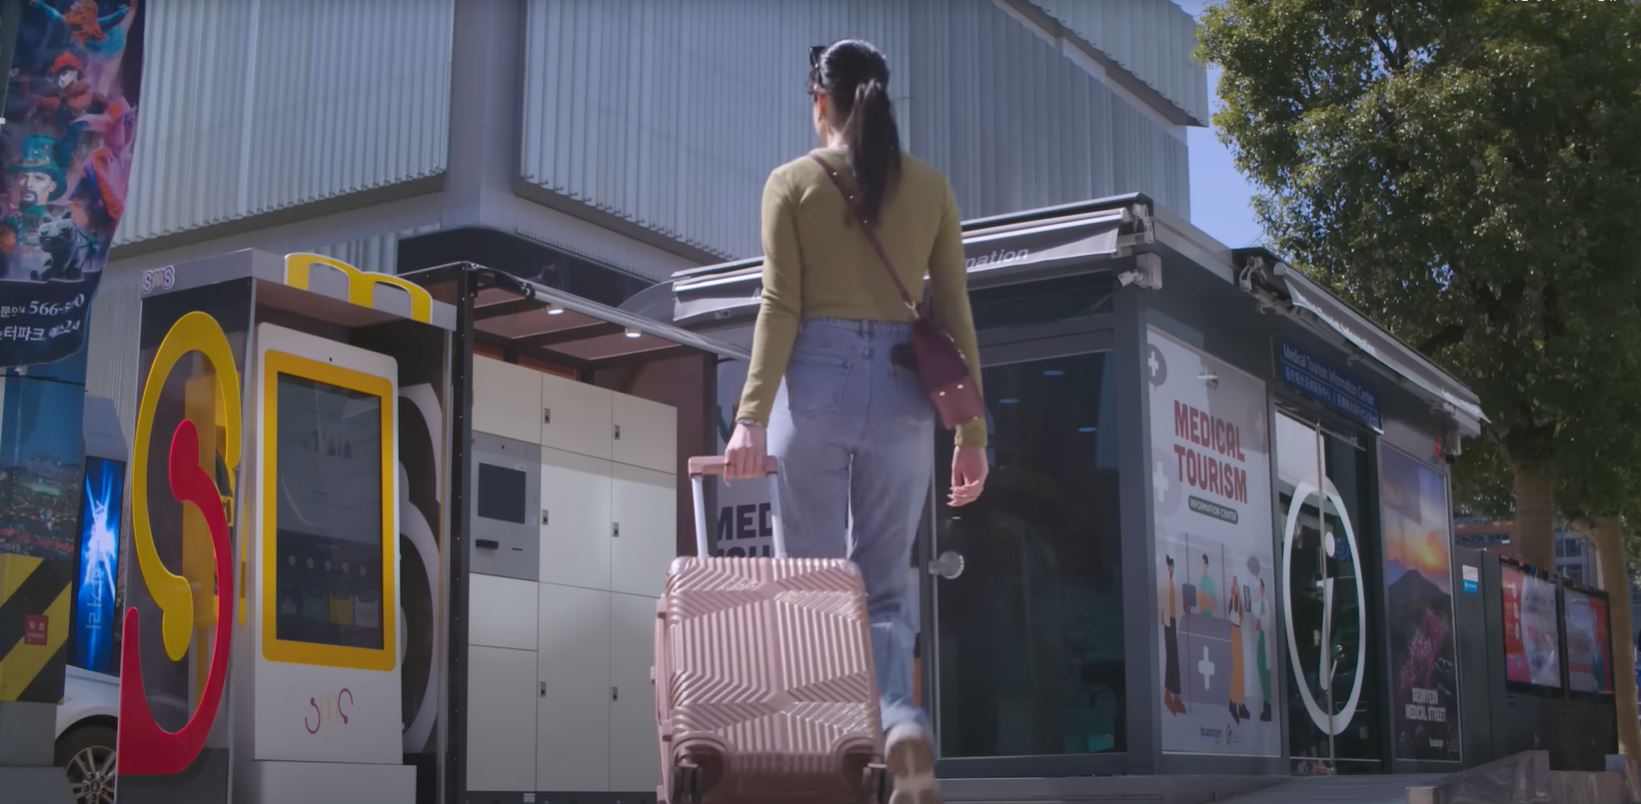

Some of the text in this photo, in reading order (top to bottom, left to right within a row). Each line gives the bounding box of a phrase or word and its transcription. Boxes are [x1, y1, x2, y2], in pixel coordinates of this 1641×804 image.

[0, 325, 46, 341] 터파크
[1174, 400, 1245, 463] MEDICAL
[1174, 443, 1248, 505] TOURISM
[1190, 498, 1220, 517] INFORMATION
